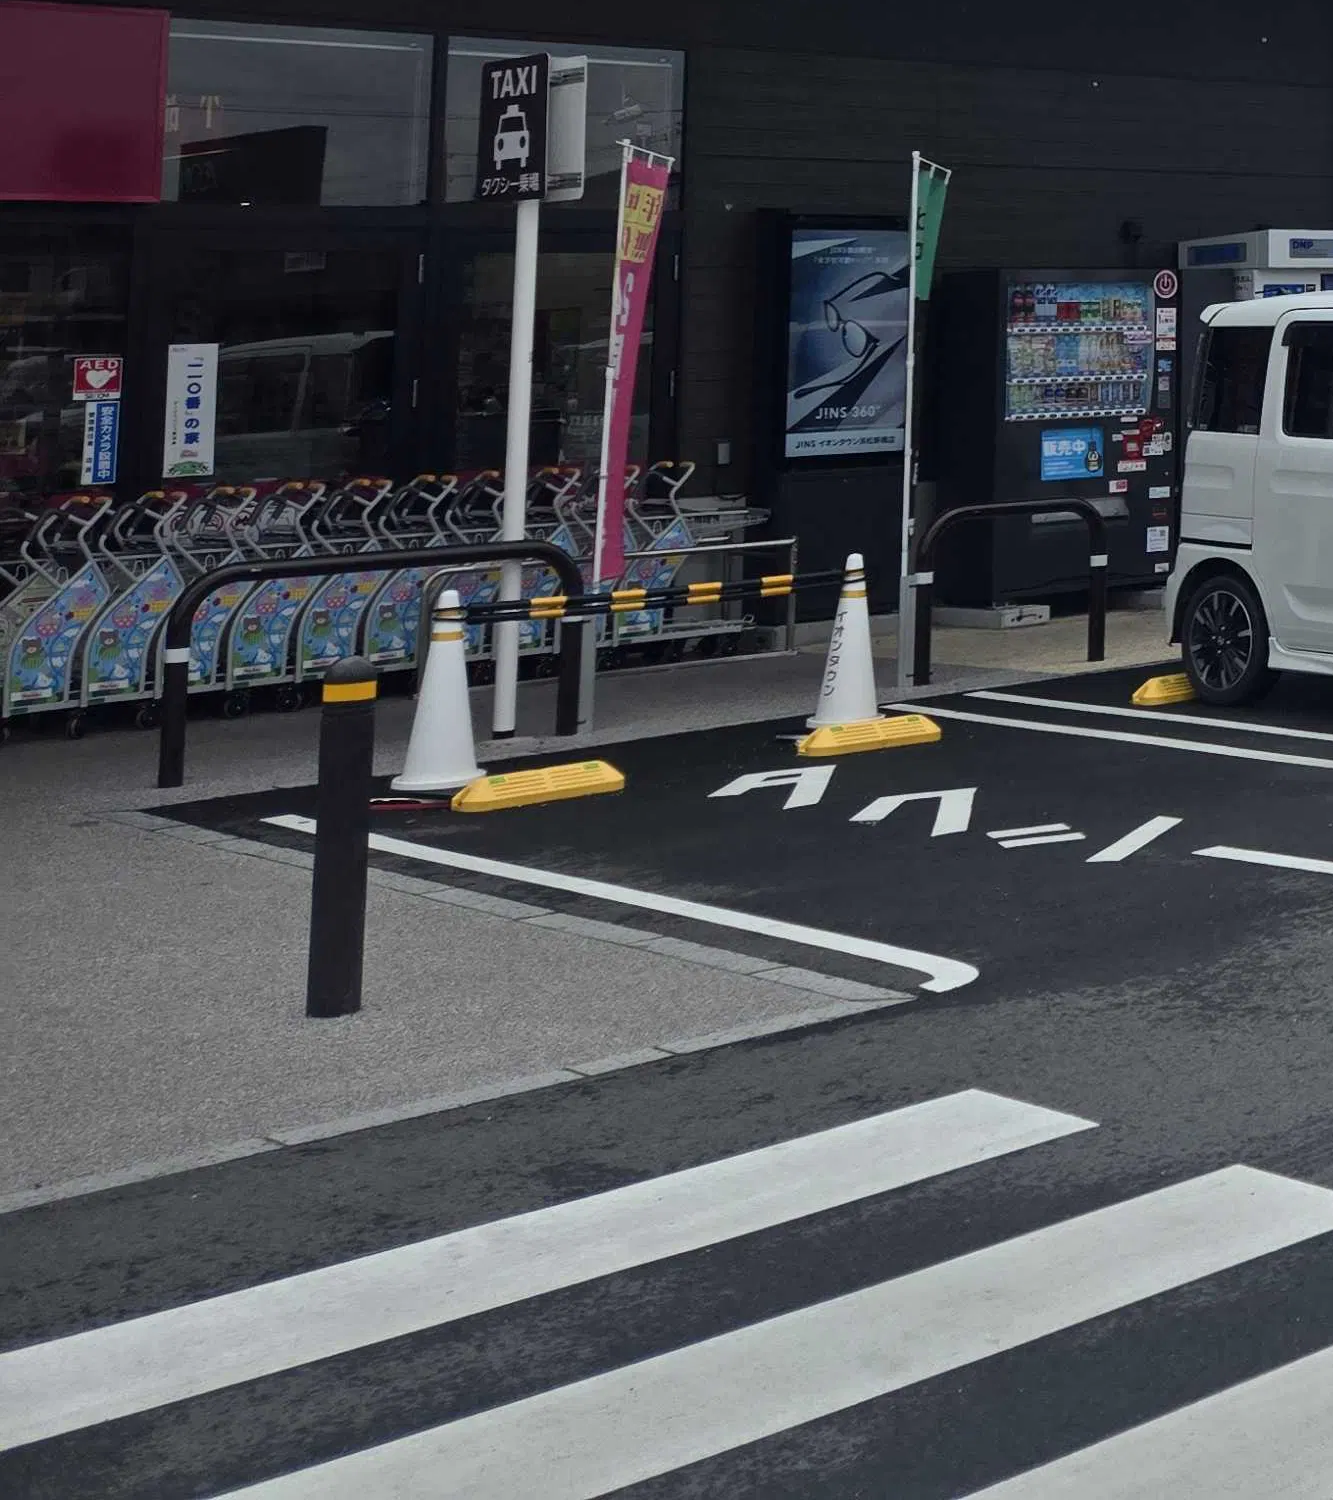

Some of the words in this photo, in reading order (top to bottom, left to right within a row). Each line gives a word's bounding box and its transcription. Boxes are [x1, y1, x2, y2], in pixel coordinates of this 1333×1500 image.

[491, 65, 537, 100] TAXI
[481, 171, 541, 196] タクシー乗場
[80, 359, 119, 370] AED
[815, 406, 848, 420] JINS
[823, 610, 849, 698] イオンタウン
